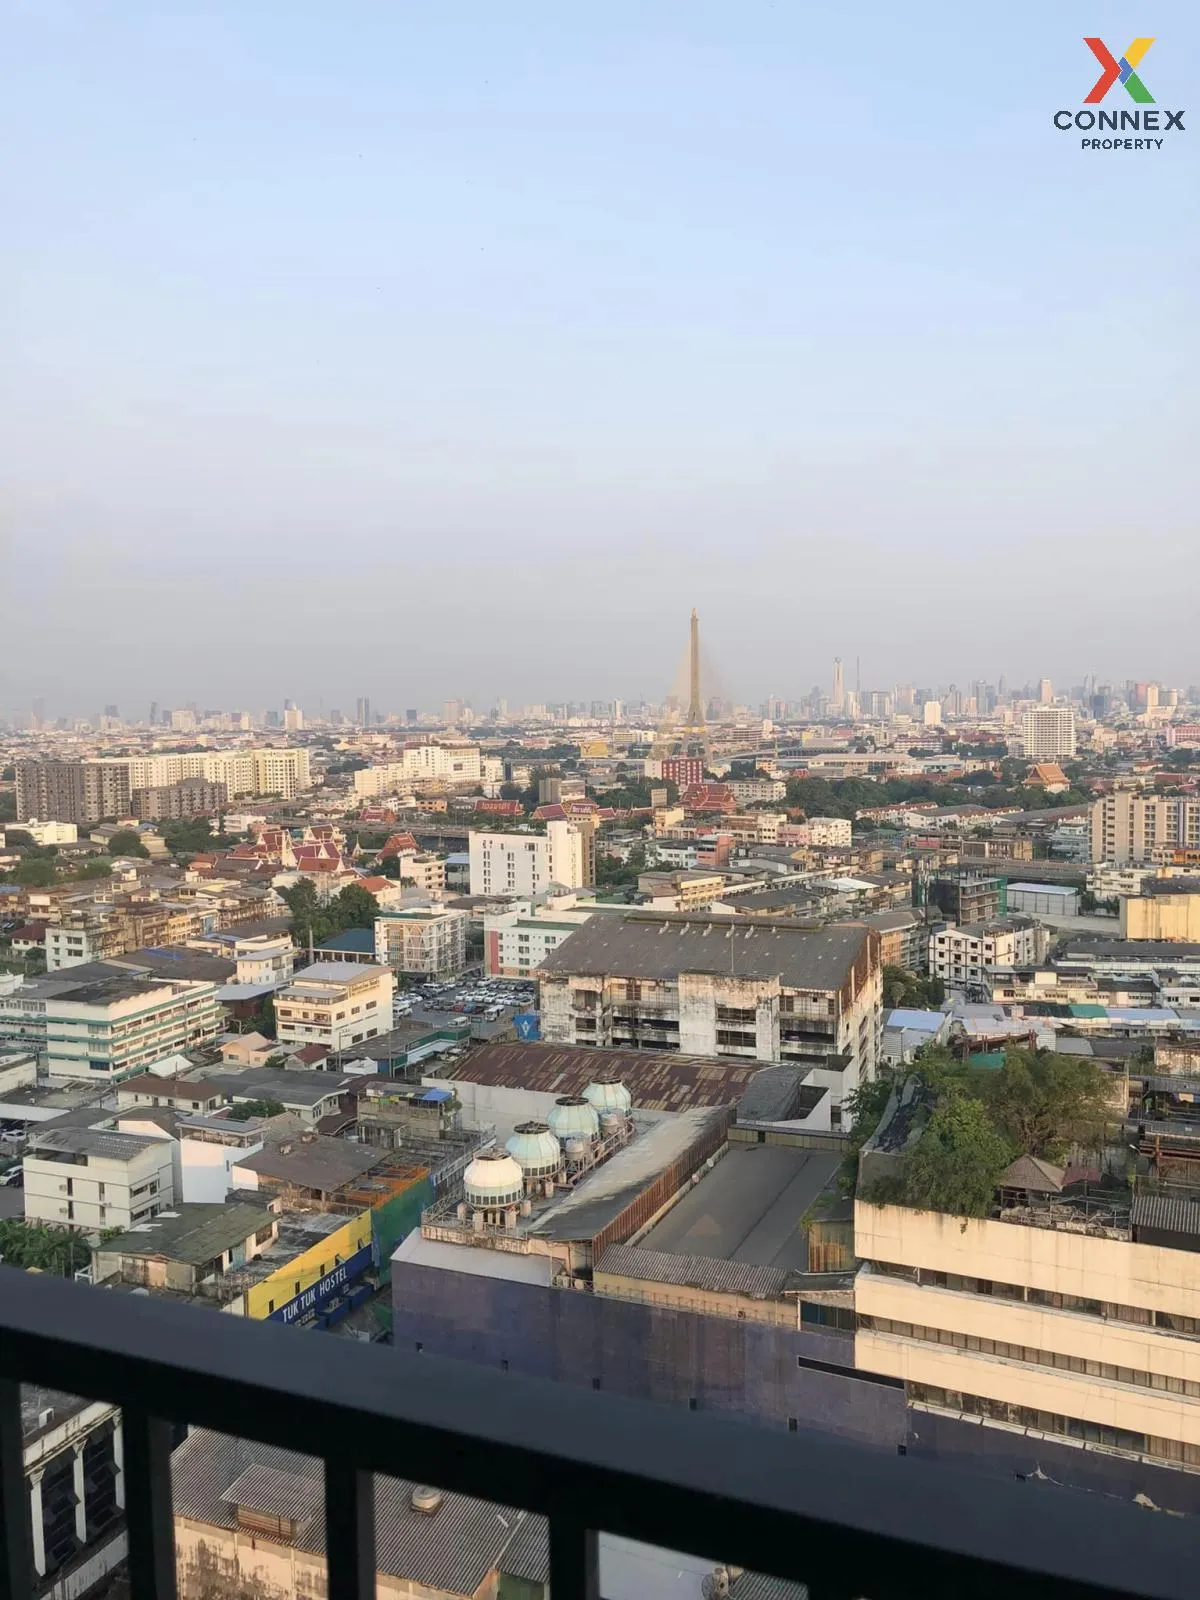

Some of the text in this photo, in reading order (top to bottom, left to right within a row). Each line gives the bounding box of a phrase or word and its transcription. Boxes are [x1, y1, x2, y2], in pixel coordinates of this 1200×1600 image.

[283, 1266, 347, 1322] TUK TUK HOSTEL
